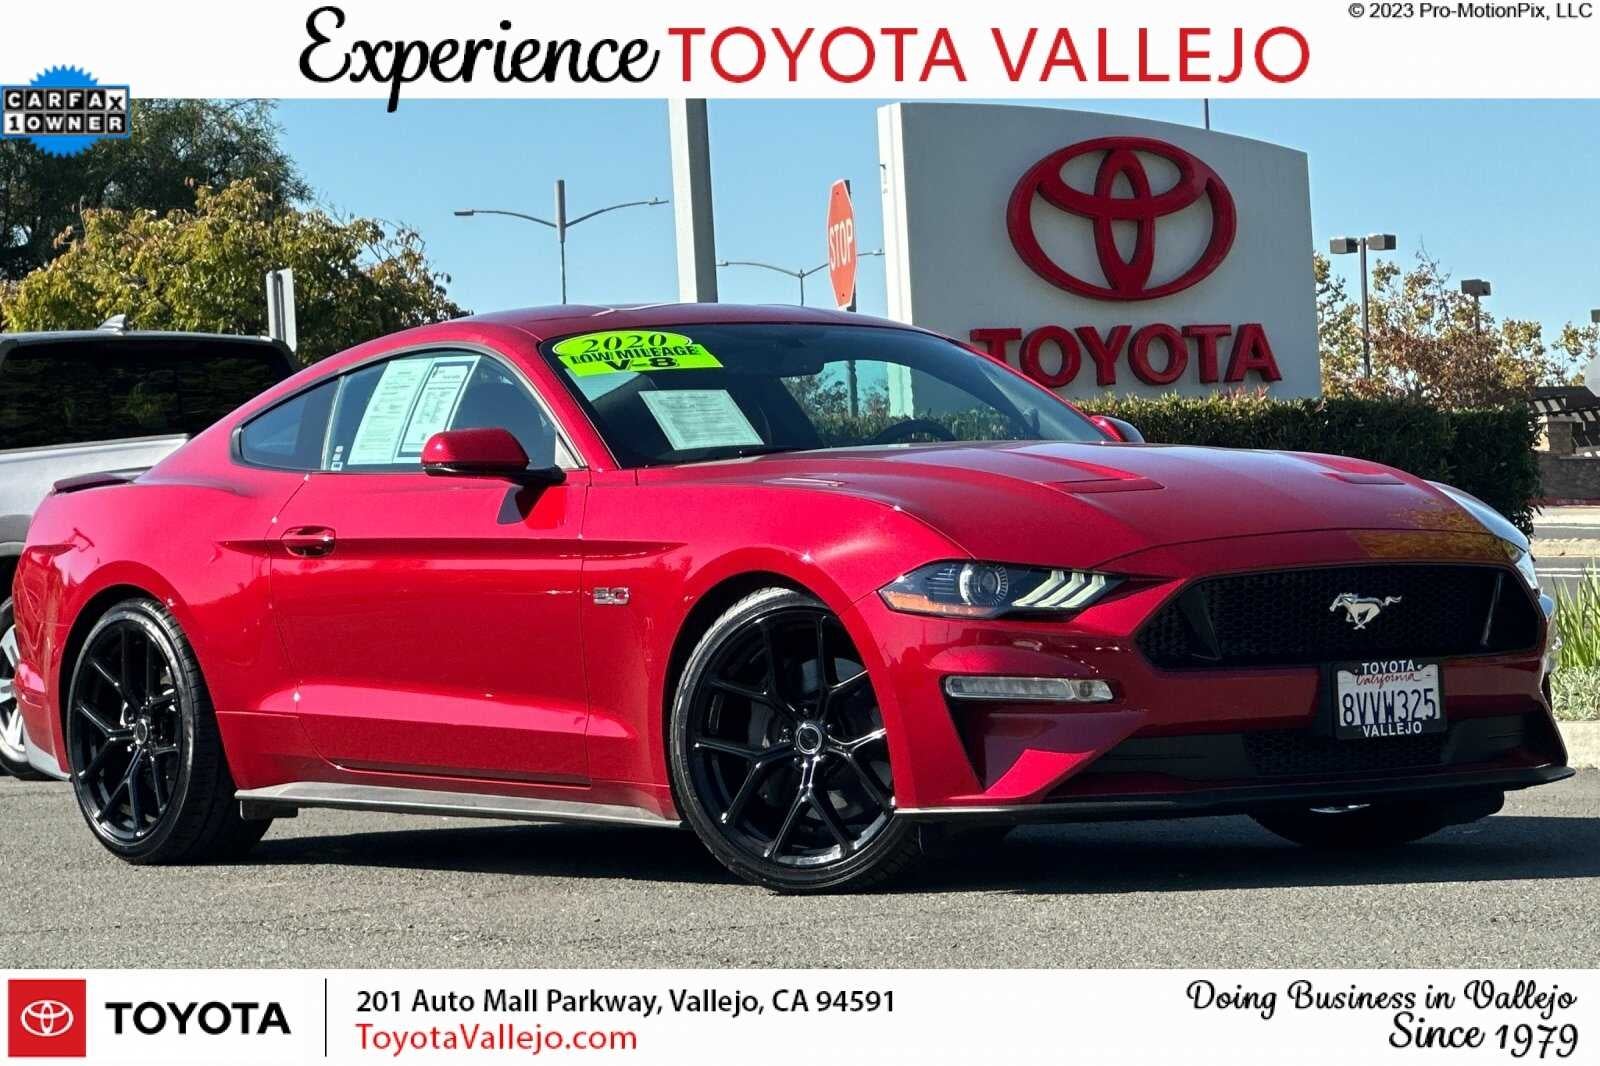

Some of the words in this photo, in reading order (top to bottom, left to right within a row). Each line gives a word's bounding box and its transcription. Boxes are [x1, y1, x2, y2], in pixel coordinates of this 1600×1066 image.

[829, 218, 853, 271] STOP
[581, 333, 667, 353] 2020
[570, 351, 610, 364] LOW
[616, 345, 697, 360] MILEAGE
[607, 356, 680, 371] V-8
[970, 322, 1282, 388] TOYOTA
[1362, 660, 1415, 674] TOYOTA
[1342, 688, 1436, 725] 8VVW325
[1363, 721, 1422, 737] VALLEJO
